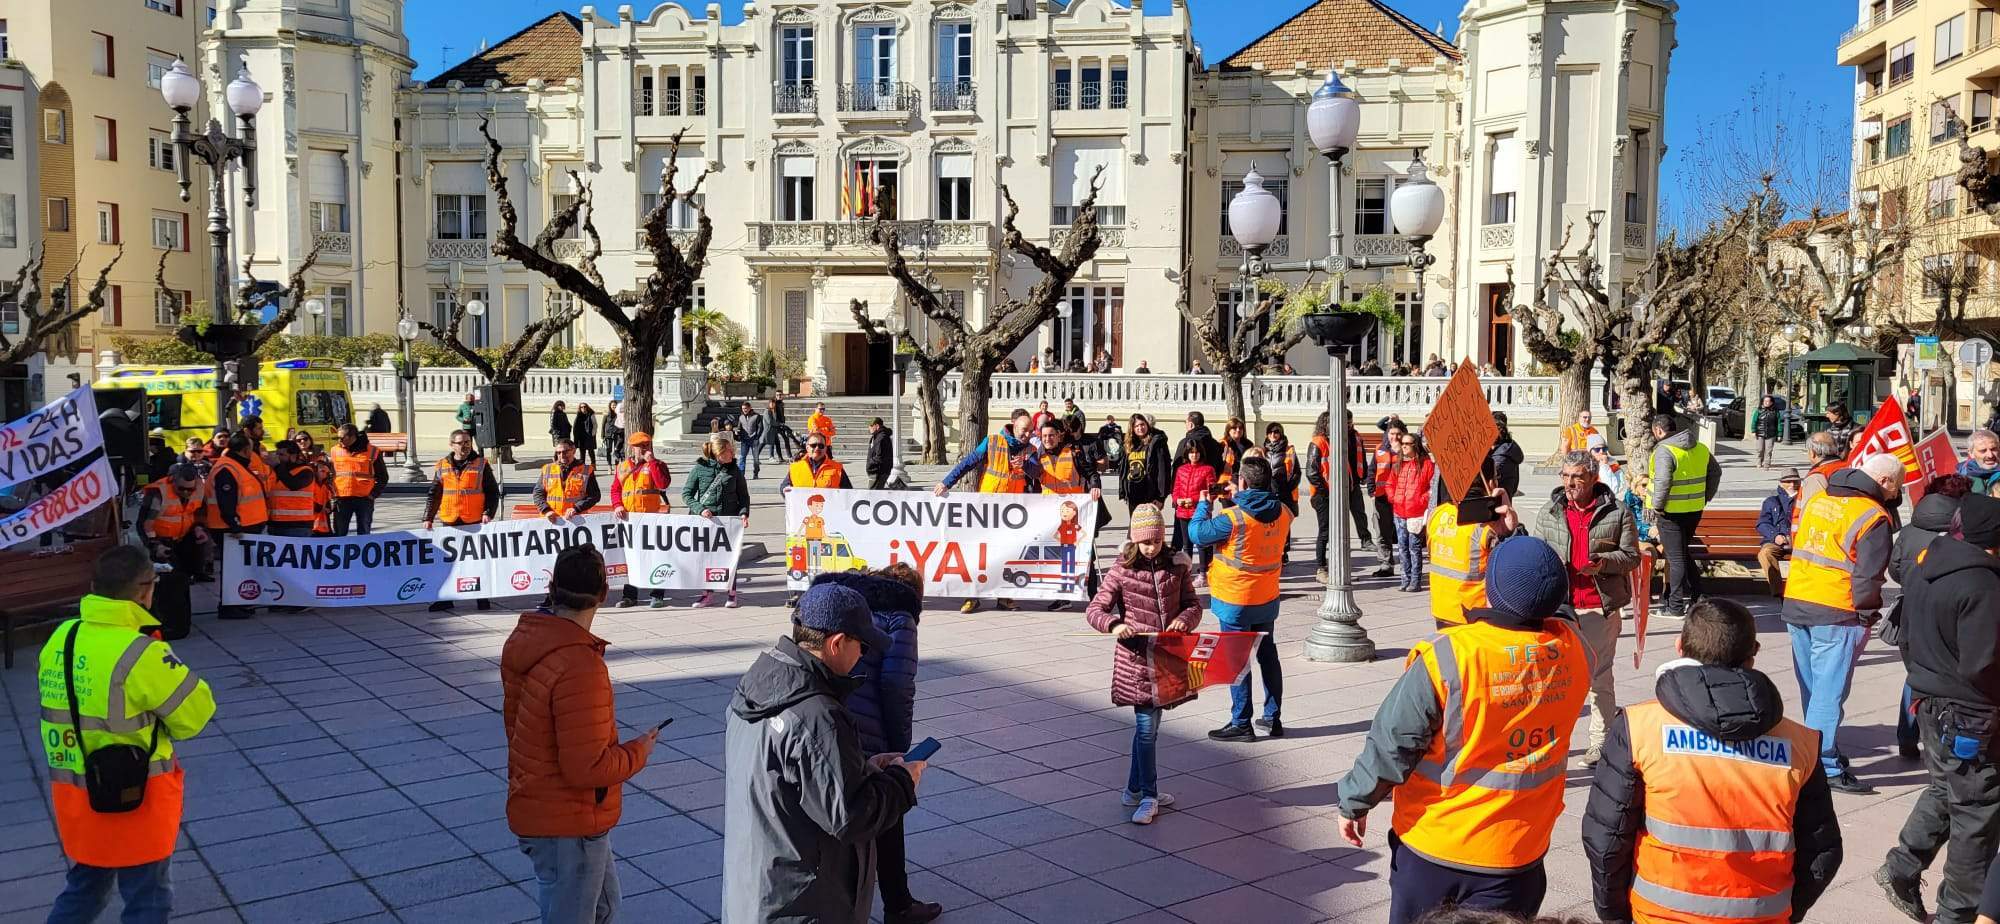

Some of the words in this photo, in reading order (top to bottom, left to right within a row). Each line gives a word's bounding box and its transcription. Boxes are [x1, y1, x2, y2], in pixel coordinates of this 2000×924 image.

[851, 500, 1028, 529] CONVENIO
[238, 538, 434, 570] TRANSPORTE
[443, 526, 592, 562] SANITARIO
[601, 523, 633, 549] EN
[642, 524, 732, 552] LUCHA
[889, 539, 988, 583] ¡YA!
[1508, 725, 1556, 748] 061
[1667, 729, 1788, 764] AMBULANCIA
